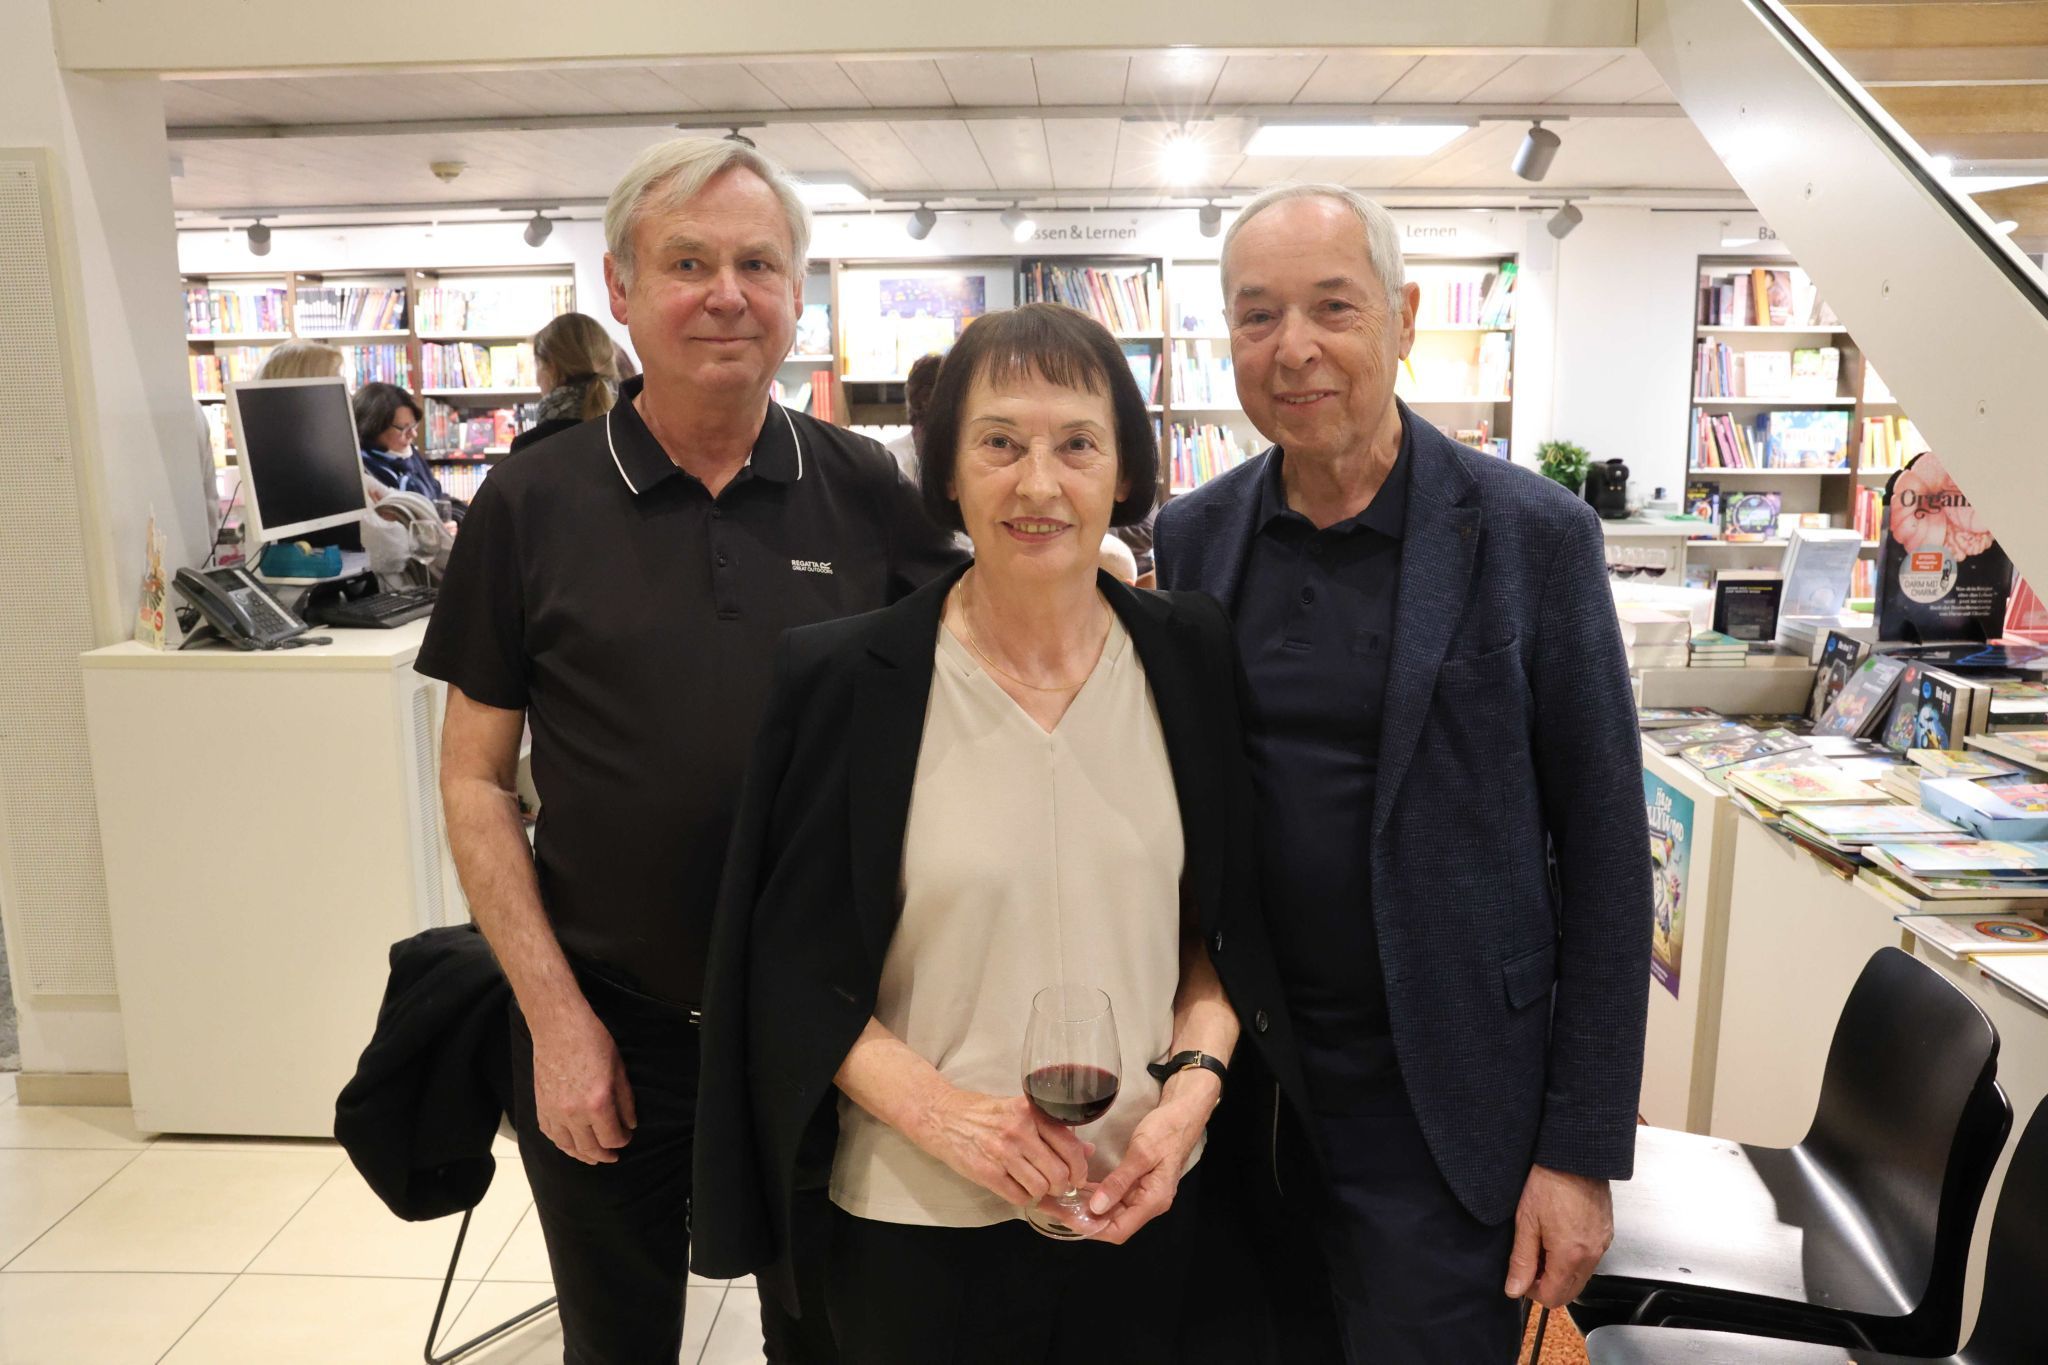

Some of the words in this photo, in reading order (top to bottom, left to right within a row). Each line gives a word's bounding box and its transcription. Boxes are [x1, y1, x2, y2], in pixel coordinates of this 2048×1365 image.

[1031, 228, 1067, 240] ssen
[1070, 225, 1082, 240] &
[1086, 226, 1137, 240] Lernen
[1406, 224, 1457, 238] Lernen
[1759, 226, 1780, 241] Ba
[1901, 489, 1972, 520] Organ
[791, 559, 820, 567] REGATTA
[1904, 580, 1925, 588] DARM
[1926, 580, 1939, 588] MIT
